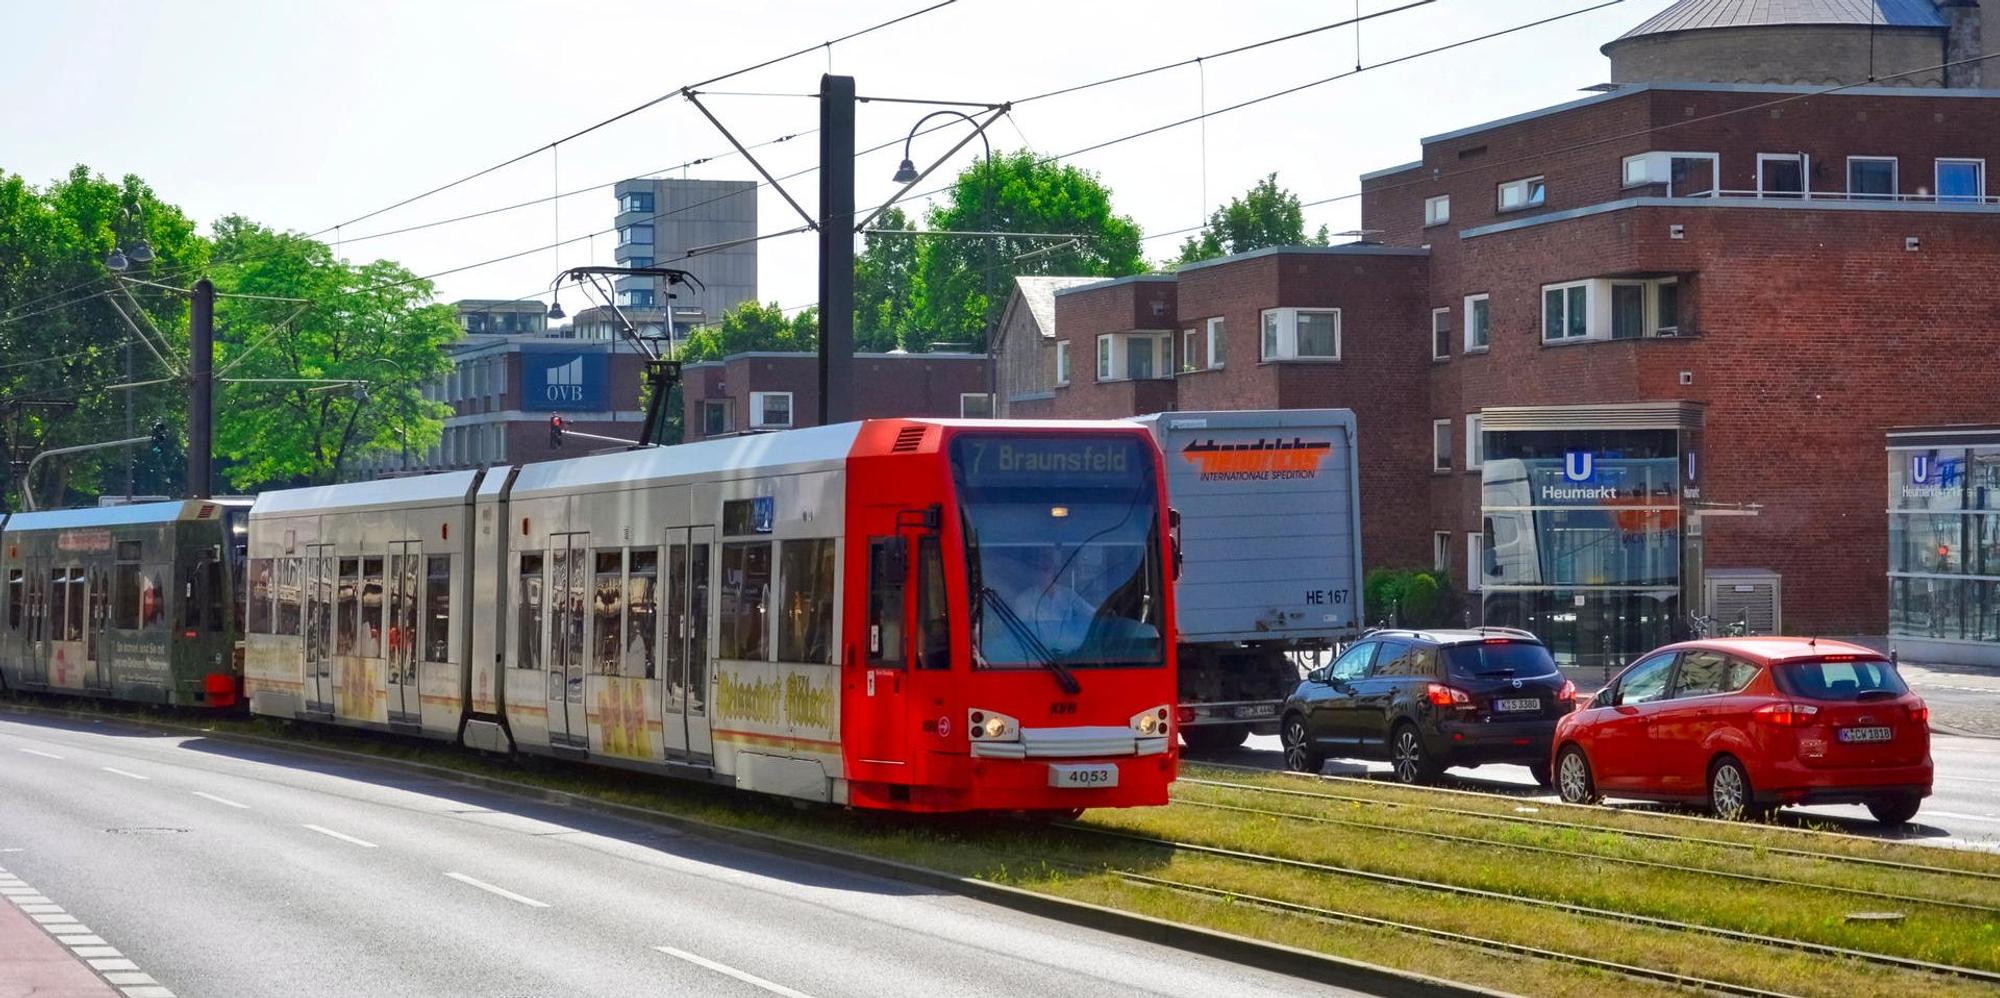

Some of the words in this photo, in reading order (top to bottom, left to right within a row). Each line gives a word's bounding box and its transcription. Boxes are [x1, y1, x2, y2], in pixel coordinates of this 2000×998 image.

[547, 386, 583, 401] OVB
[971, 443, 987, 474] 7
[1000, 444, 1127, 472] Braunsfeld
[1565, 453, 1592, 481] U
[1913, 456, 1928, 483] U
[1200, 472, 1270, 482] INTERNATIONALE
[1271, 470, 1316, 480] SPEDITION
[1542, 485, 1616, 499] Heumarkt
[1306, 590, 1323, 605] HE
[1327, 589, 1348, 605] 167
[1069, 770, 1108, 783] 4053
